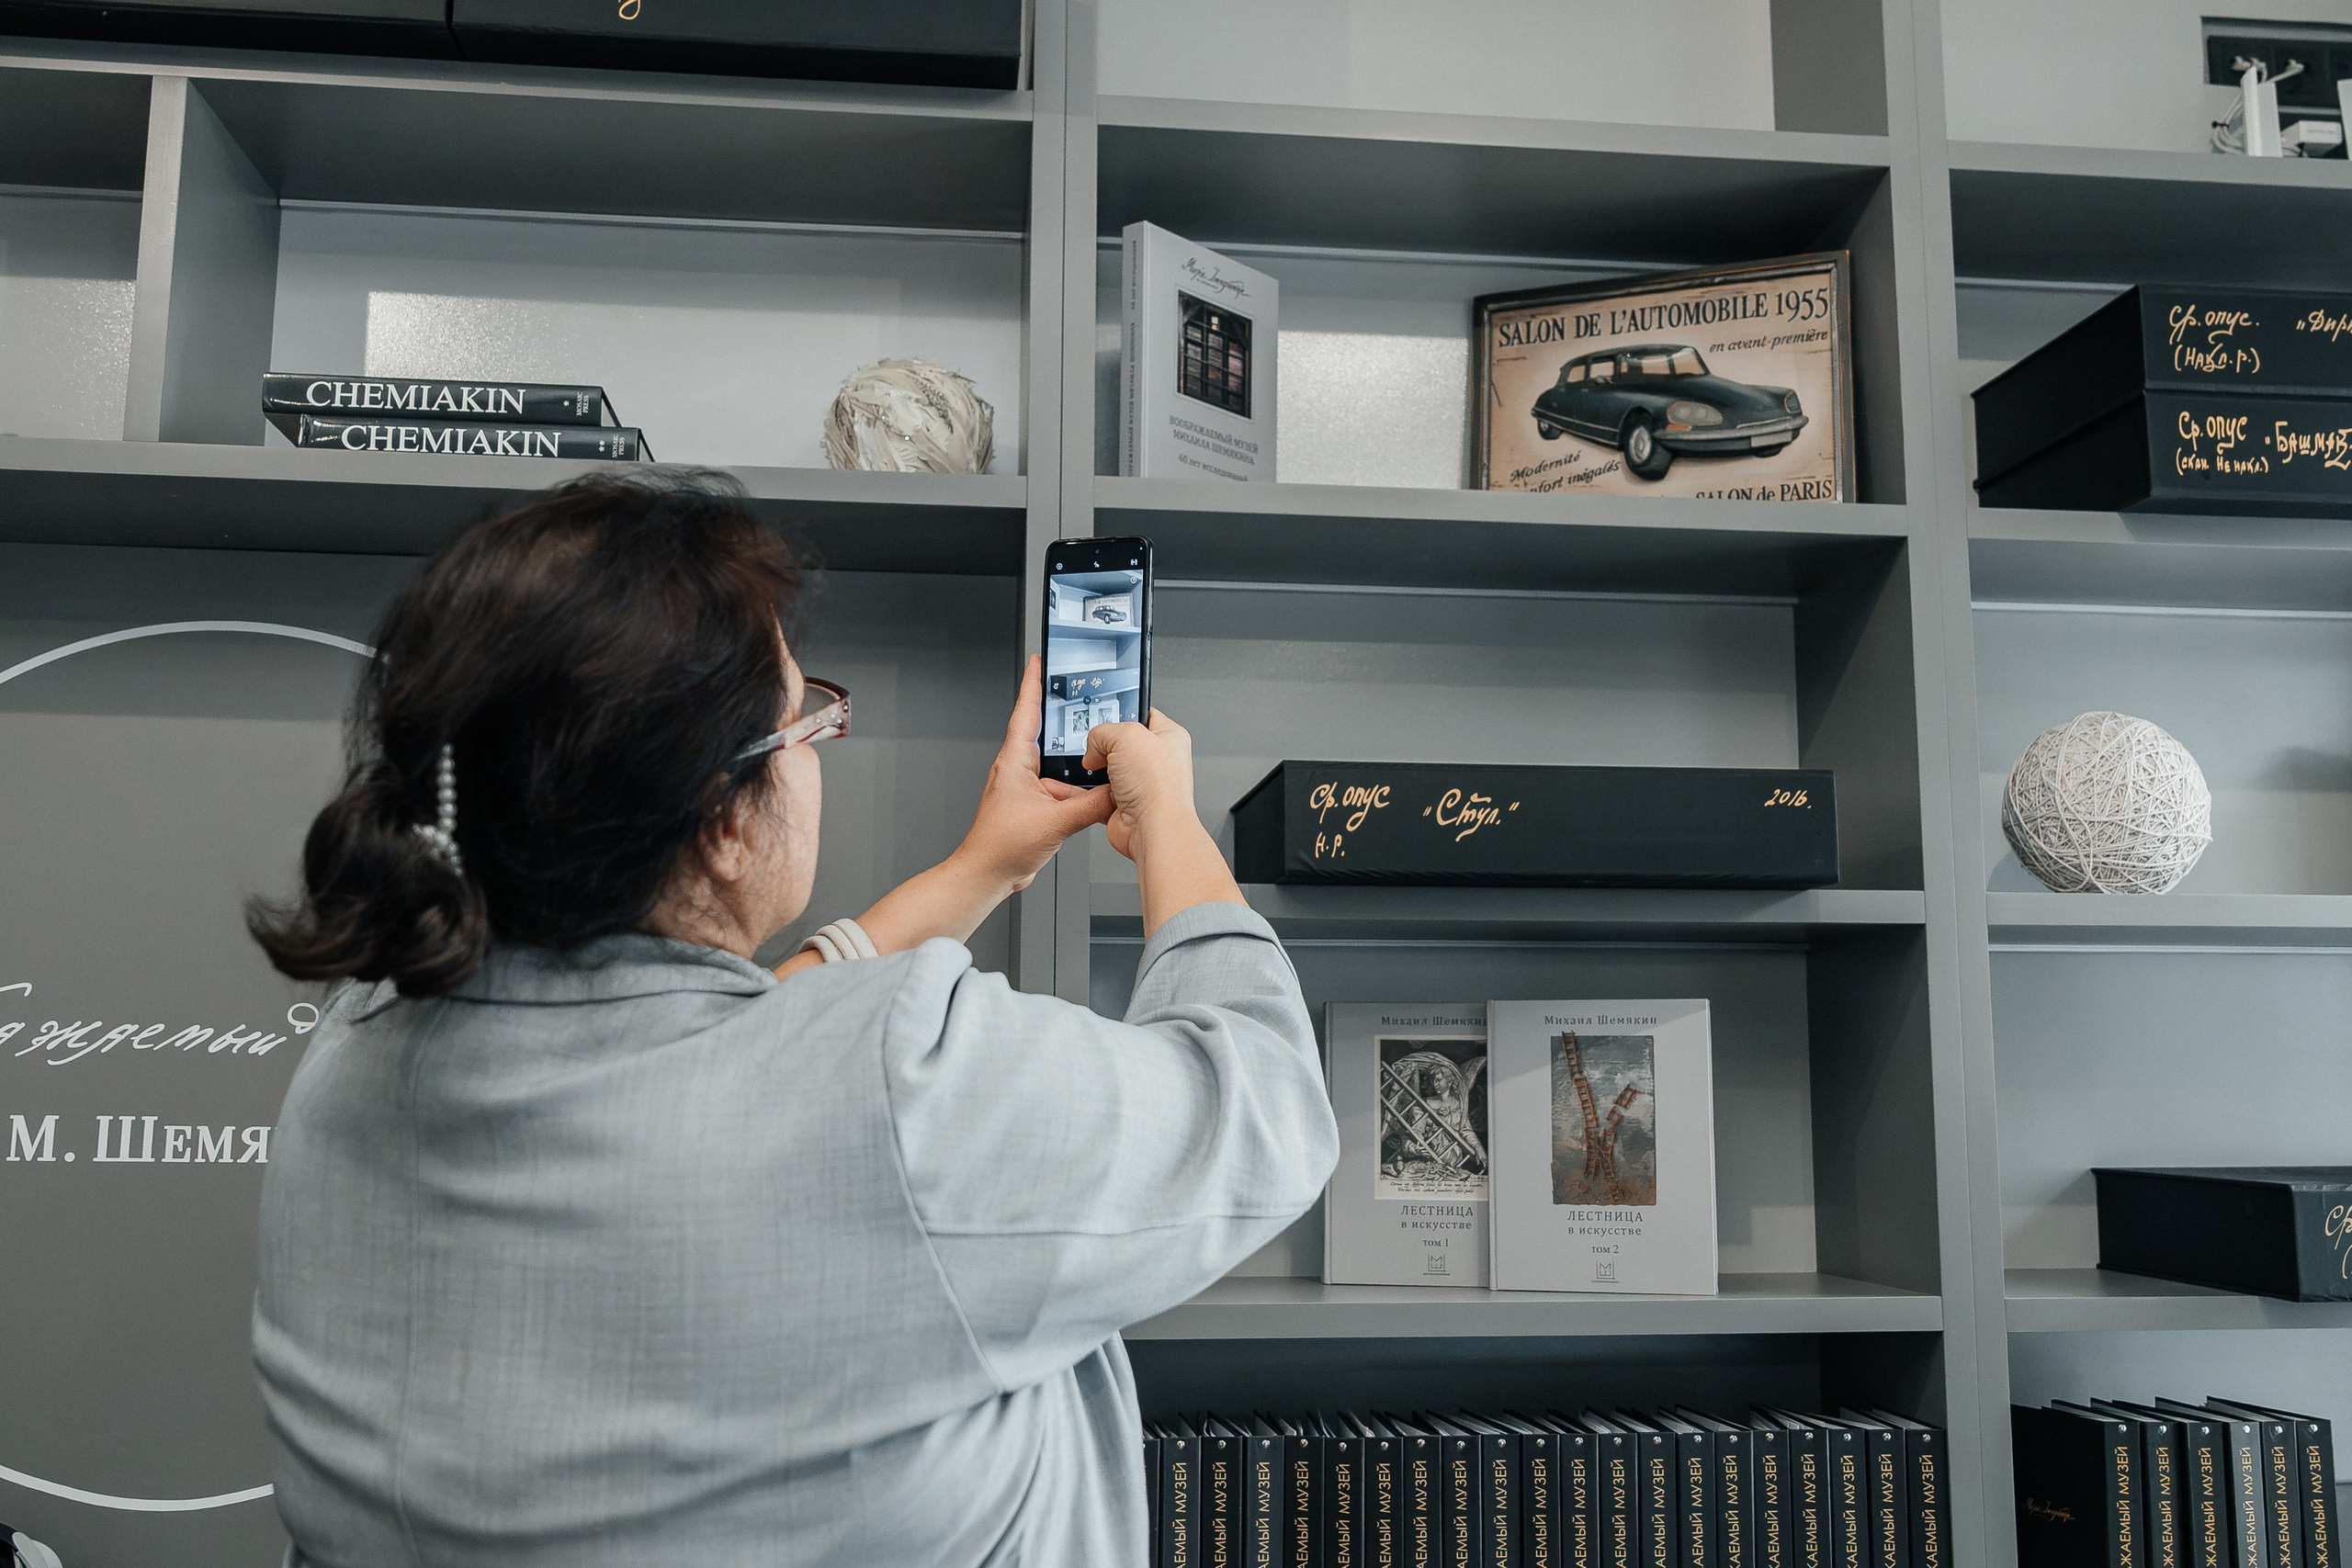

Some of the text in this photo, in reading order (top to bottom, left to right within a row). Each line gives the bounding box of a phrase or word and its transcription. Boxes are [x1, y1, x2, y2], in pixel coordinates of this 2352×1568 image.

[1498, 288, 1828, 348] SALON DE L'AUTOMOBILE 1955
[1709, 329, 1828, 354] en avant-première
[306, 380, 526, 414] CHEMIAKIN
[341, 424, 561, 458] CHEMIAKIN
[1510, 450, 1581, 483] Modernité
[1567, 459, 1622, 483] inégalés
[1756, 485, 1776, 501] de
[1780, 479, 1832, 502] PARIS
[1381, 1016, 1428, 1027] Михаил
[1544, 1014, 1657, 1025] Михаил Шемякин
[6, 1114, 277, 1164] М. ШЕМЯ
[1400, 1205, 1474, 1218] ЛЕСТНИЦА
[1411, 1221, 1472, 1232] искусстве
[1567, 1210, 1644, 1224] ЛЕСТНИЦА
[1567, 1226, 1642, 1237] в искусстве
[1422, 1237, 1449, 1247] том 1
[1590, 1244, 1620, 1254] том 2
[1172, 1463, 1186, 1513] МУЗЕЙ
[1213, 1462, 1227, 1512] МУЗЕЙ
[1257, 1462, 1270, 1512] МУЗЕЙ
[1295, 1461, 1308, 1511] МУЗЕЙ
[1336, 1464, 1350, 1514] МУЗЕЙ
[1376, 1463, 1391, 1513] МУЗЕЙ
[1413, 1461, 1427, 1510] МУЗЕЙ
[1453, 1461, 1467, 1510] МУЗЕЙ
[1493, 1460, 1507, 1508] МУЗЕЙ
[1532, 1459, 1546, 1508] МУЗЕЙ
[1571, 1460, 1585, 1508] МУЗЕЙ
[1611, 1460, 1624, 1508] МУЗЕЙ
[1651, 1459, 1665, 1508] МУЗЕЙ
[1763, 1455, 1777, 1504] МУЗЕЙ
[1801, 1454, 1815, 1503] МУЗЕЙ
[1841, 1455, 1855, 1504] МУЗЕЙ
[1879, 1454, 1894, 1503] МУЗЕЙ
[1919, 1455, 1935, 1503] МУЗЕЙ
[2307, 1446, 2323, 1494] МУЗЕЙ
[1689, 1458, 1703, 1568] АЕМЫЙ МУЗЕЙ
[1723, 1455, 1740, 1568] АЕМЫЙ МУЗЕЙ
[2115, 1447, 2132, 1568] ЖАЕМЫЙ МУЗЕЙ
[2158, 1447, 2174, 1568] ЖАЕМЫЙ МУЗЕЙ
[2199, 1448, 2217, 1568] ЖАЕМЫЙ МУЗЕЙ
[2242, 1448, 2257, 1568] ЖАЕМЫЙ МУЗЕЙ
[2271, 1447, 2291, 1568] ЖАЕМЫЙ МУЗЕЙ
